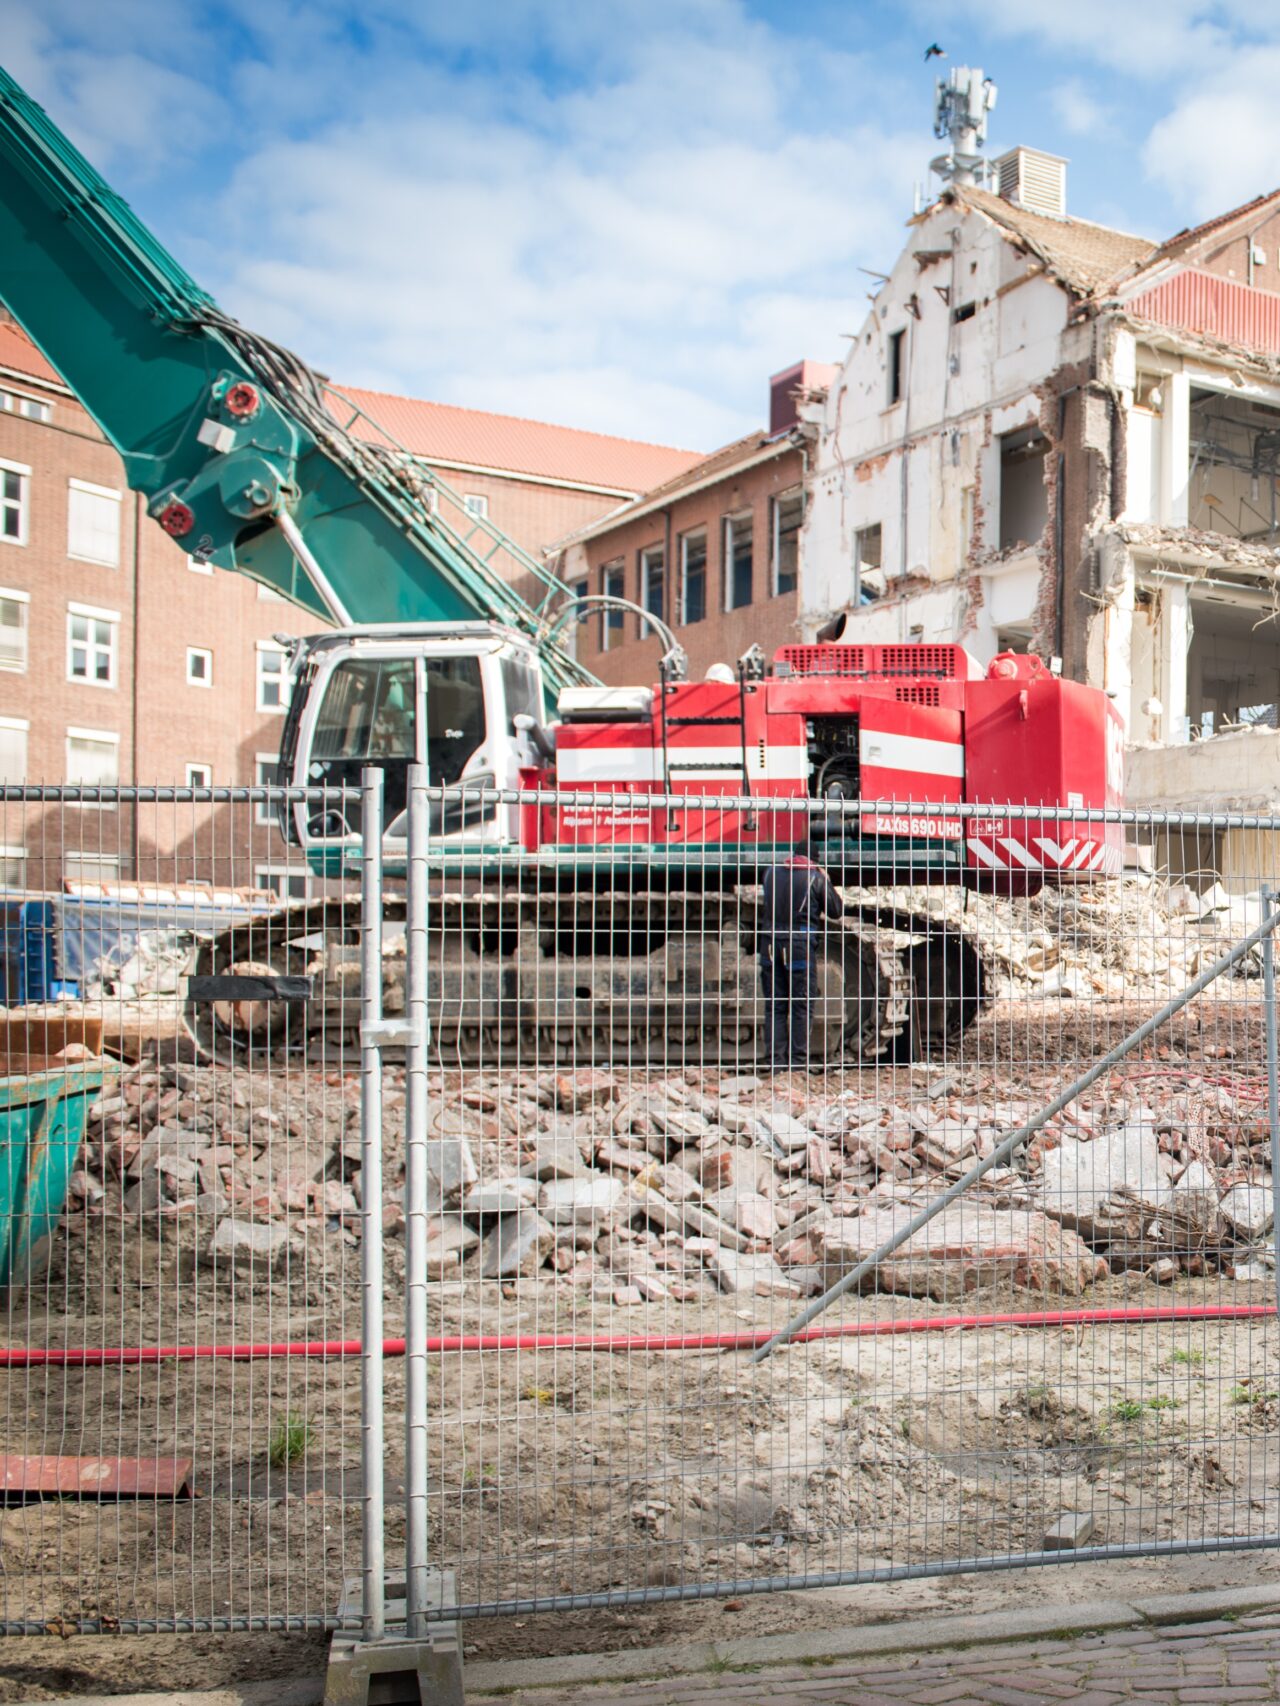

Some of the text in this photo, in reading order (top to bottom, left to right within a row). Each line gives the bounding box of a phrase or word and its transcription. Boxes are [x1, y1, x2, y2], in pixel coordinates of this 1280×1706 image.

[877, 817, 963, 838] ZAXIS 690 UHD
